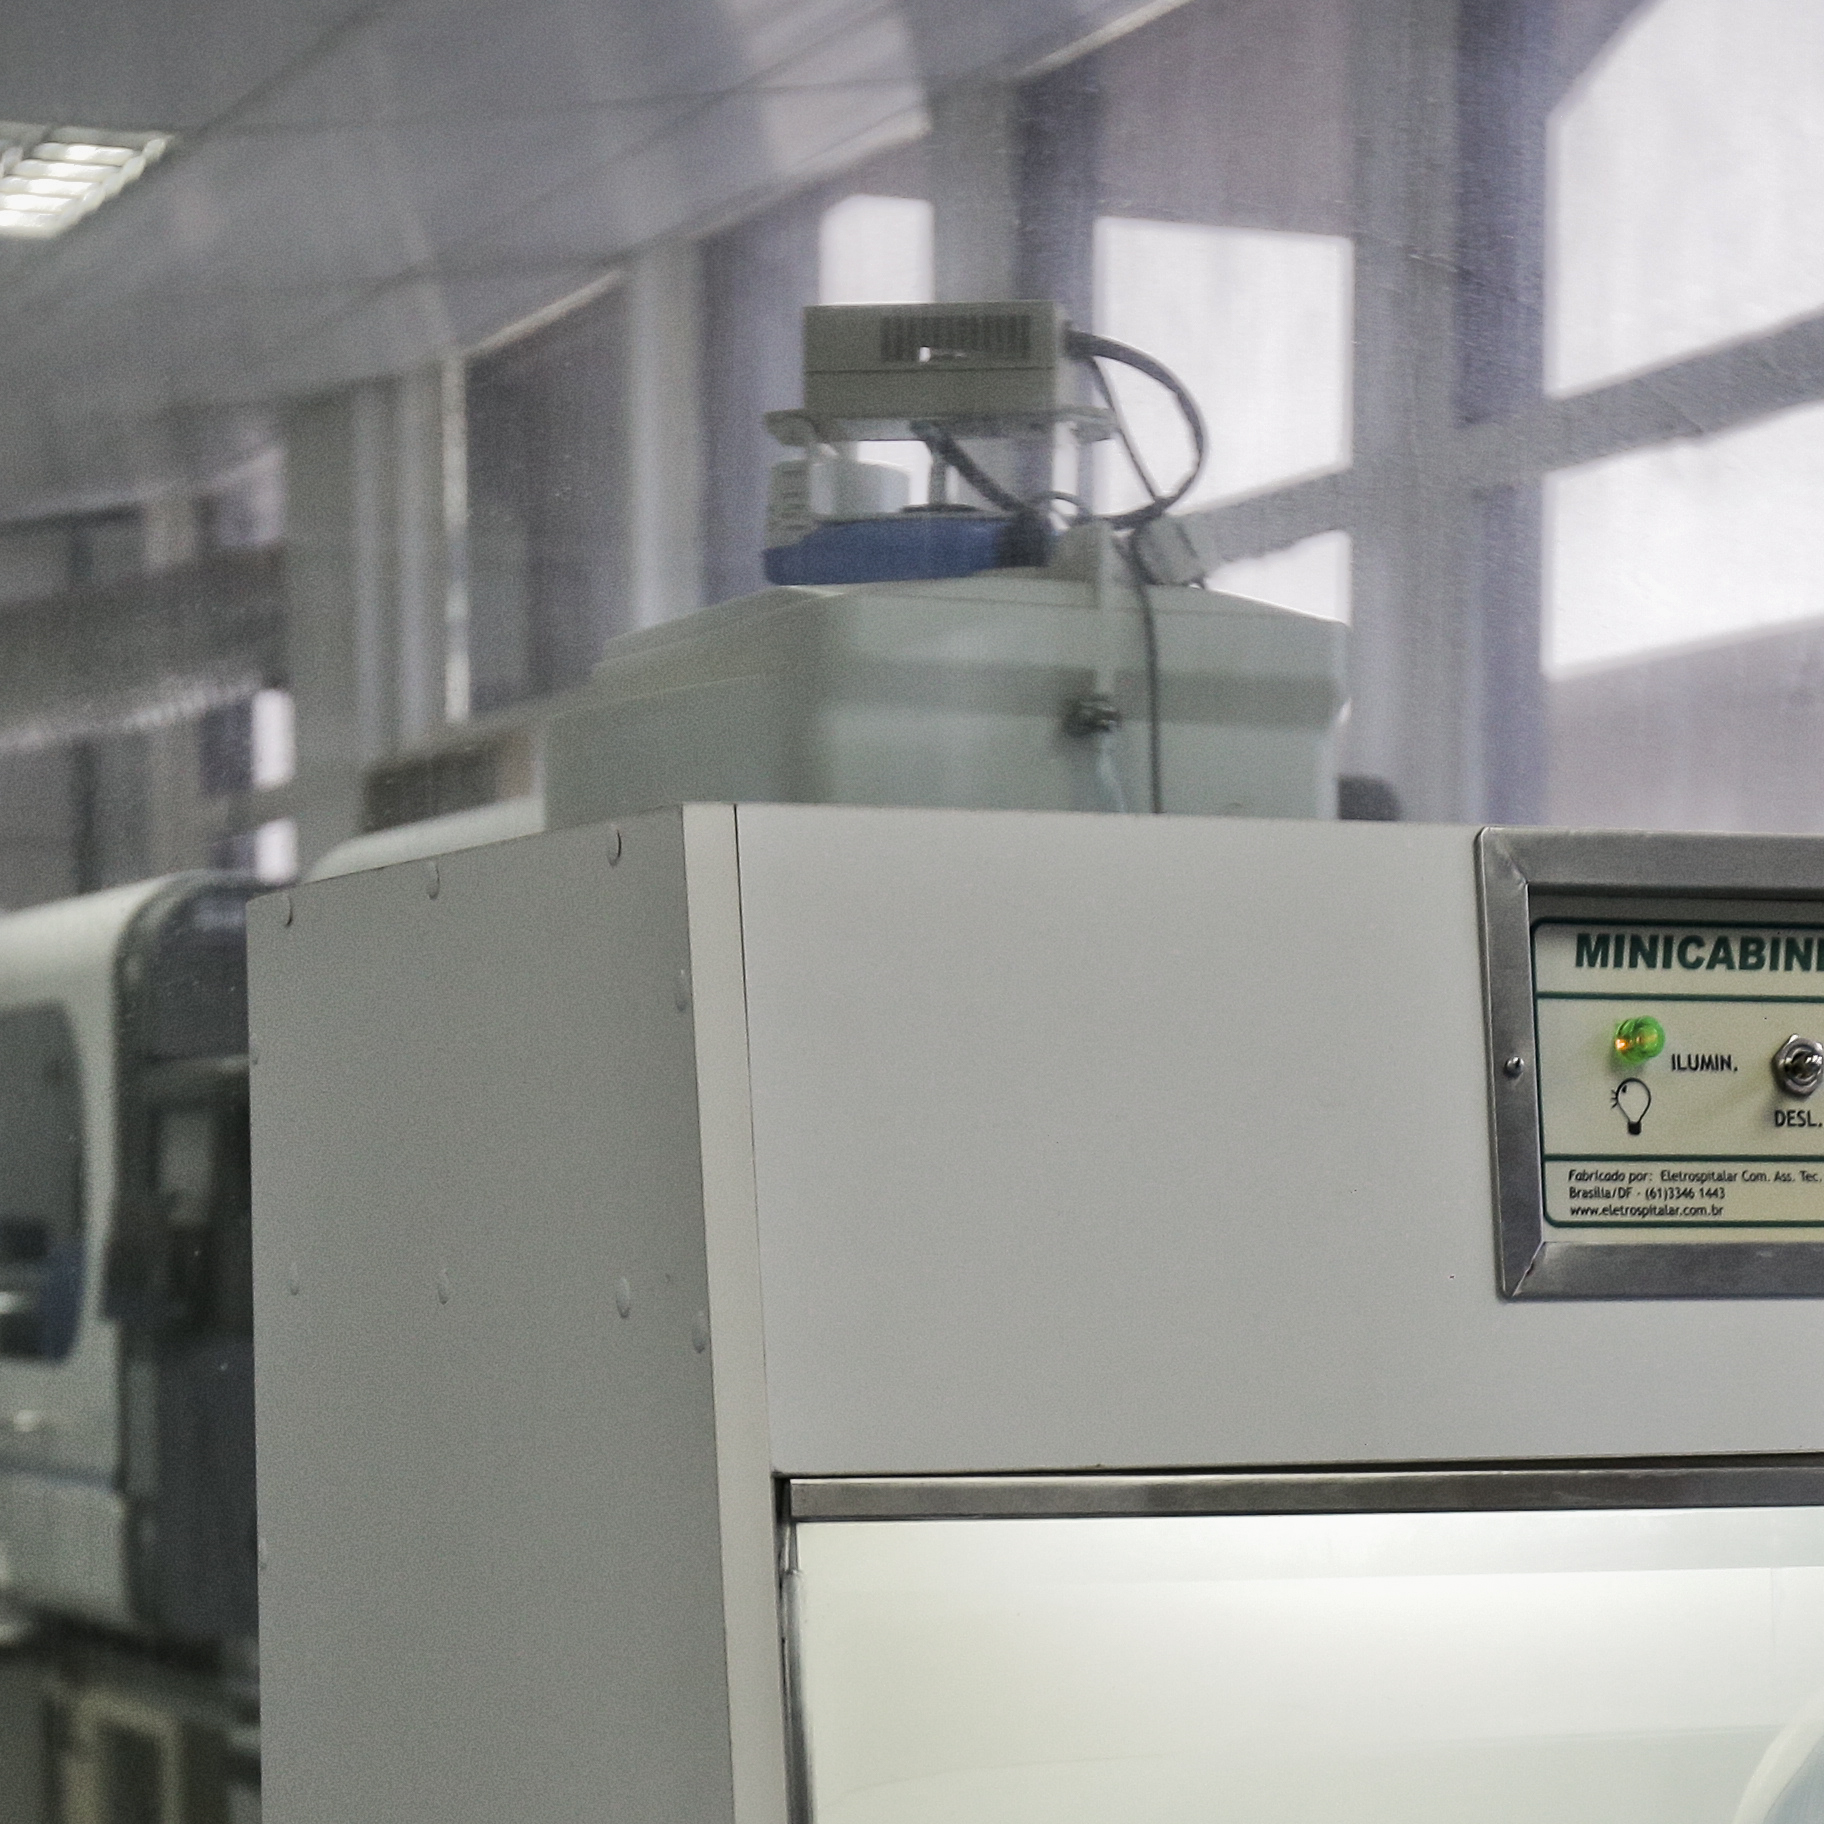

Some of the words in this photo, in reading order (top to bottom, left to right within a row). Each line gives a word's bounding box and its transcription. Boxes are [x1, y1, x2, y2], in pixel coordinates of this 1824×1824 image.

[1671, 1053, 1739, 1073] ILUMIN.
[1774, 1110, 1824, 1128] DESL.
[1568, 1169, 1625, 1182] Fabricado
[1628, 1171, 1653, 1184] por:
[1660, 1169, 1737, 1184] Eletrospitalar
[1742, 1170, 1771, 1182] Com.
[1774, 1170, 1796, 1183] Ass.
[1699, 1187, 1725, 1199] 1443
[1570, 1204, 1723, 1219] www.eletrospitalar.com.br
